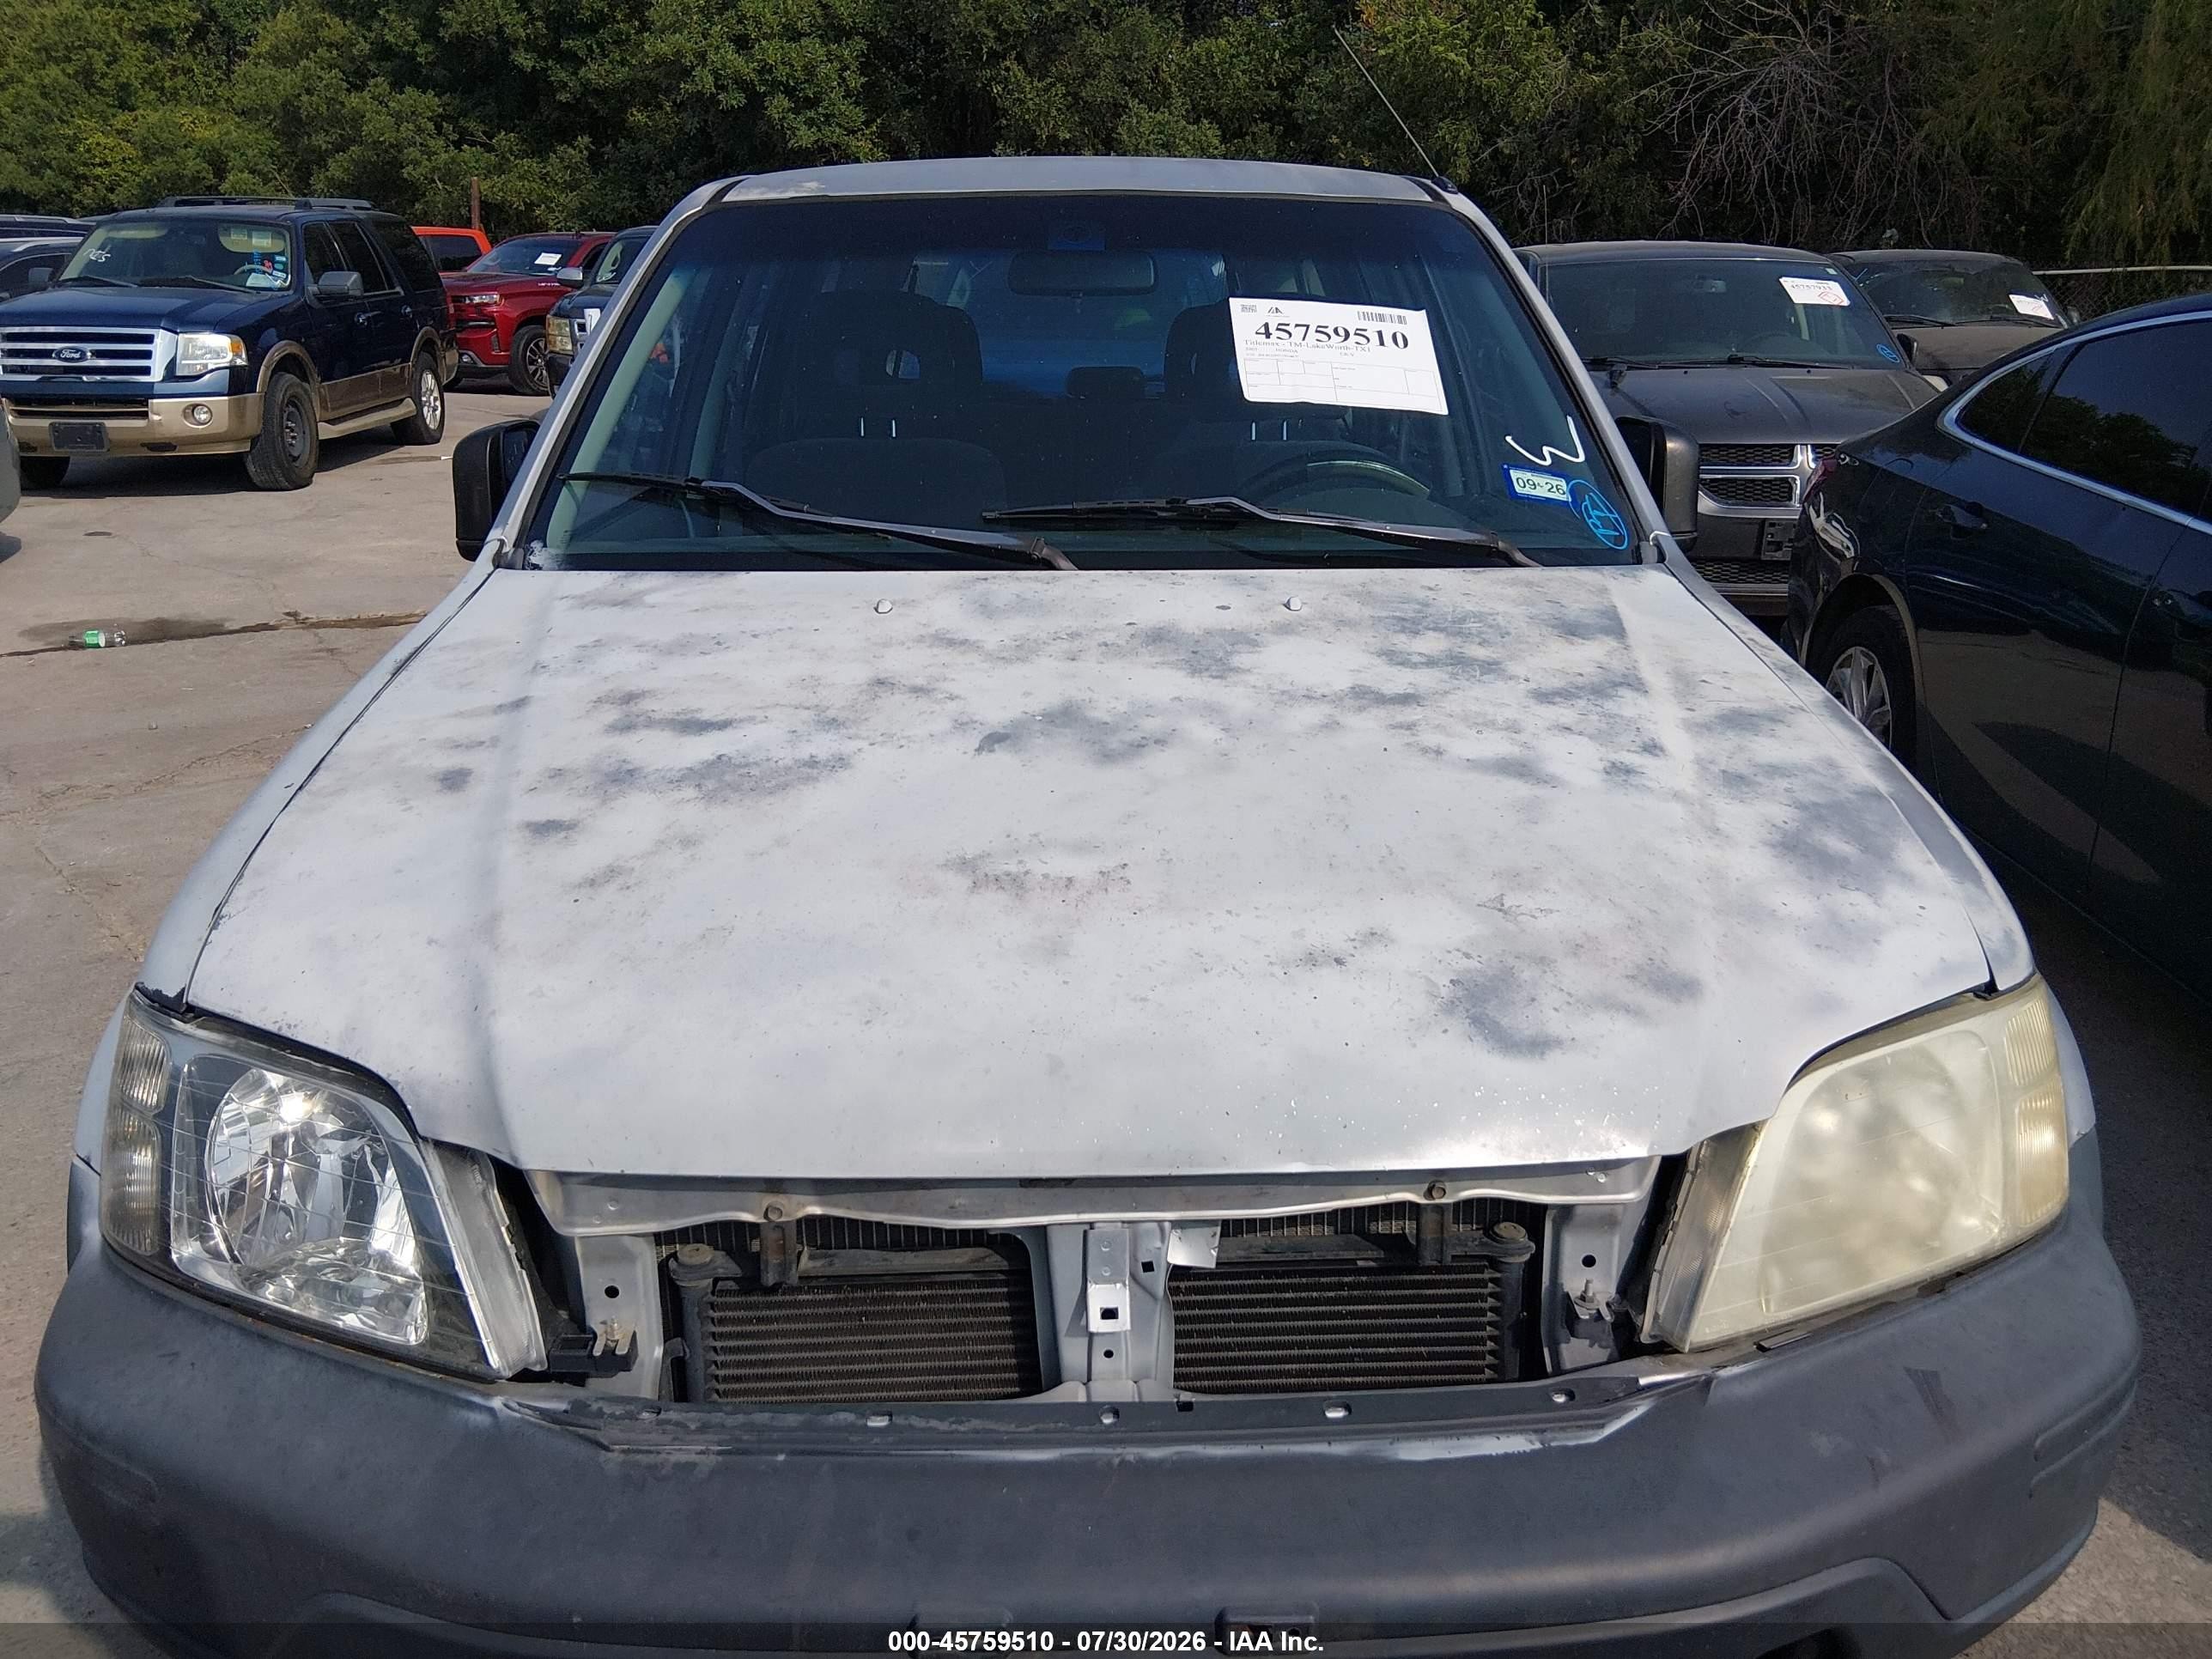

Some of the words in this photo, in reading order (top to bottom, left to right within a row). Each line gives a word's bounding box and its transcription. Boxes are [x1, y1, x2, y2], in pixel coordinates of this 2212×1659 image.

[1255, 321, 1408, 349] 45759510
[60, 349, 81, 359] Ford
[1516, 477, 1536, 490] 09
[1545, 482, 1566, 495] 26
